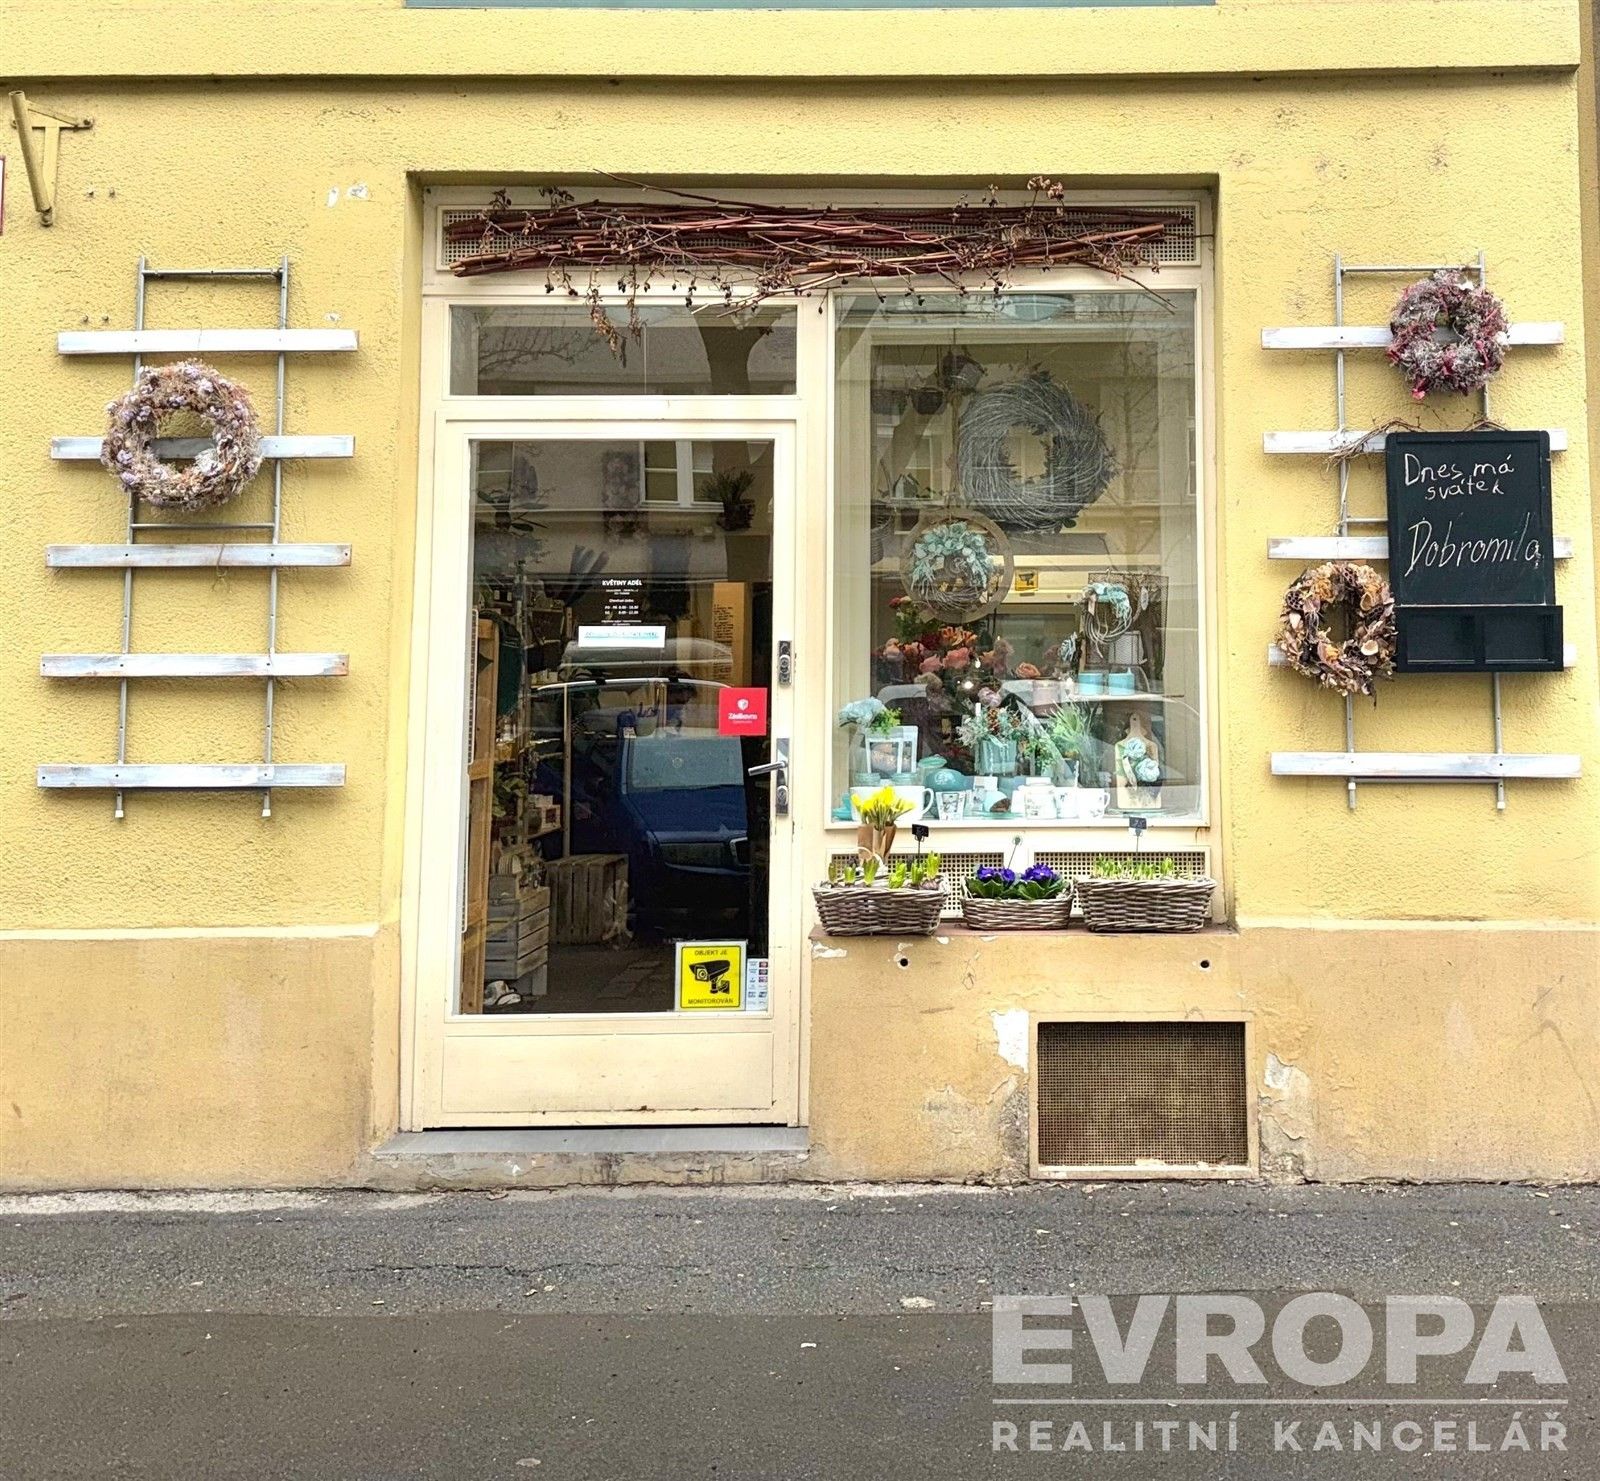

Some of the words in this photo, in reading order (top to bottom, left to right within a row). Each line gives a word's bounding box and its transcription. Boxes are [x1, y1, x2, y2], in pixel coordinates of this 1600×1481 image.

[1404, 453, 1463, 486] Dnes
[1473, 454, 1515, 477] má
[1425, 475, 1504, 500] svátek
[1404, 512, 1541, 577] Dobromila
